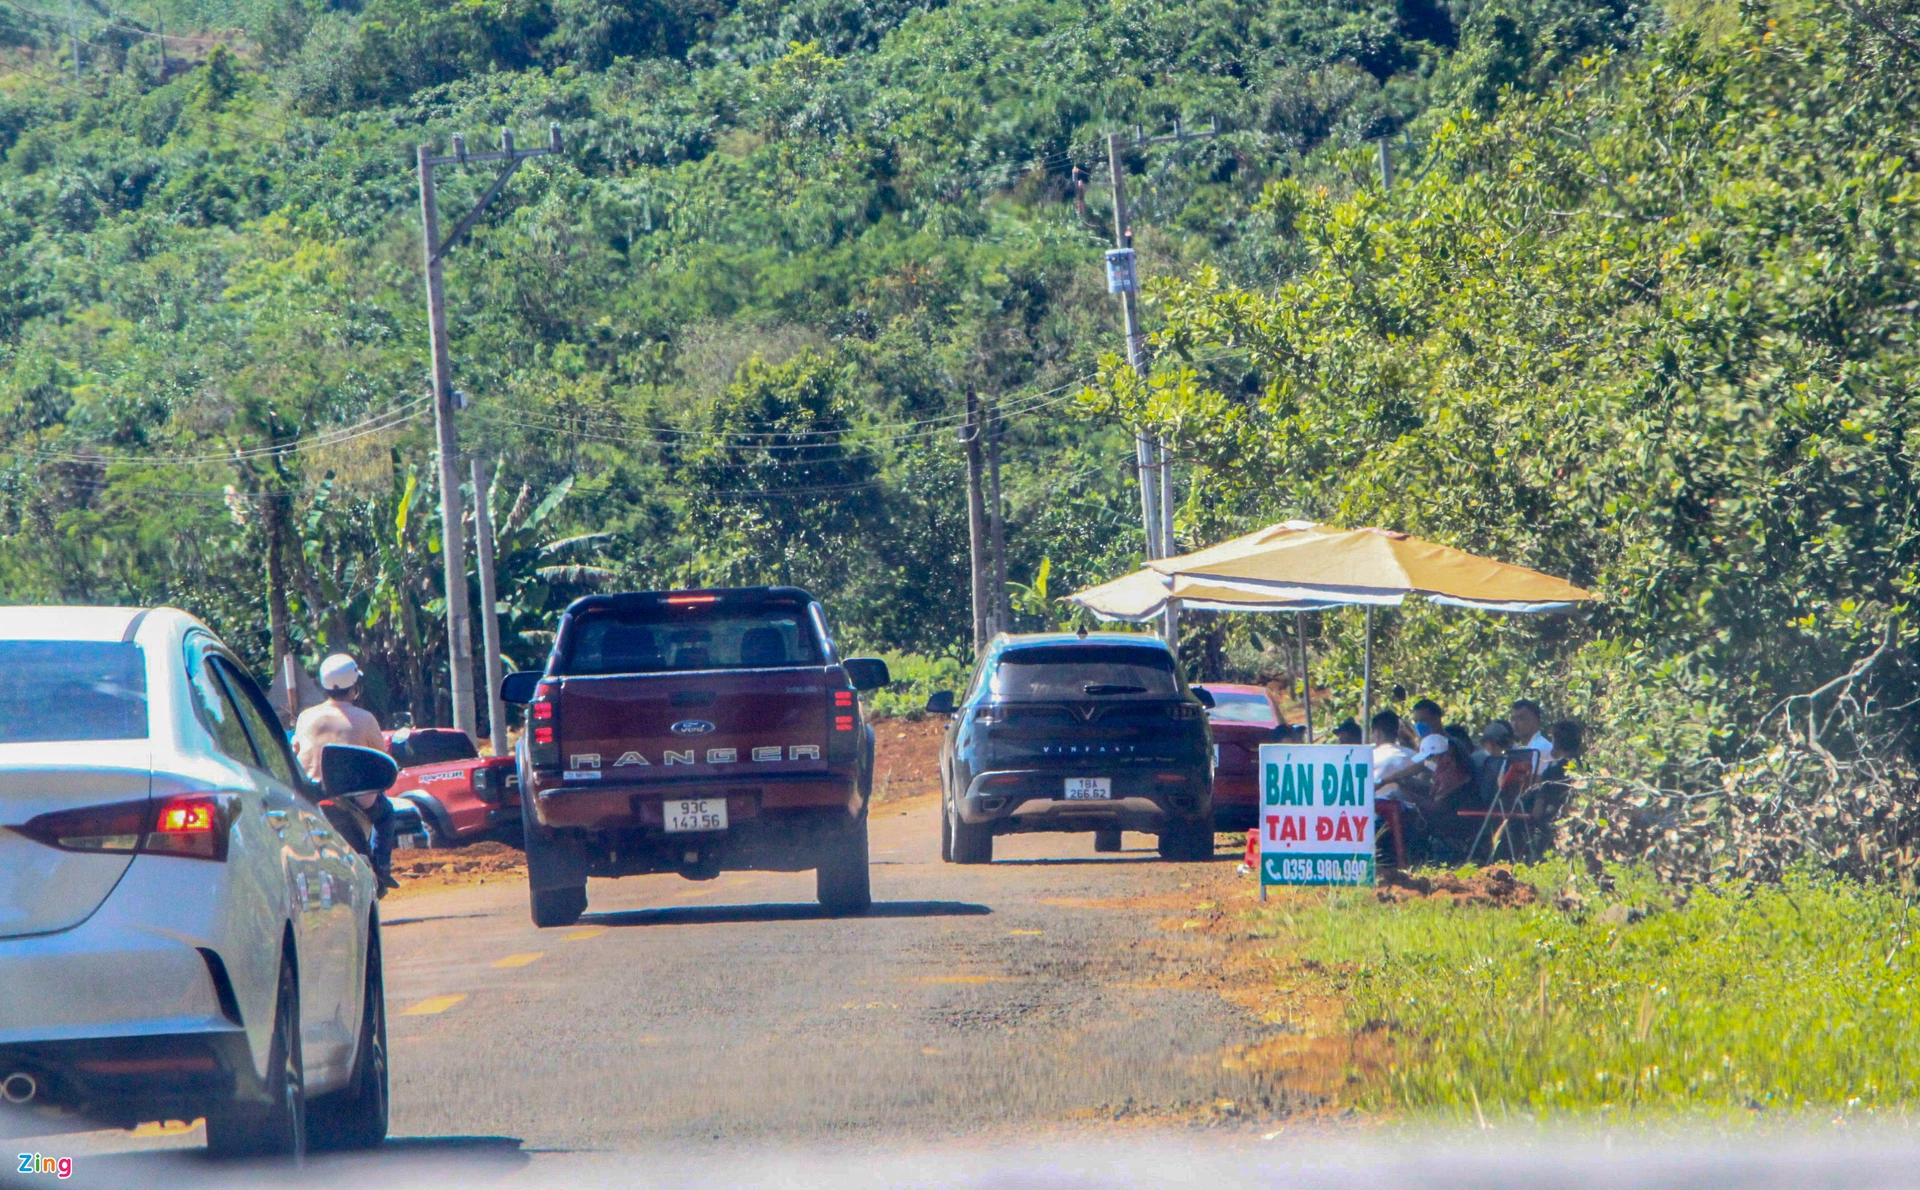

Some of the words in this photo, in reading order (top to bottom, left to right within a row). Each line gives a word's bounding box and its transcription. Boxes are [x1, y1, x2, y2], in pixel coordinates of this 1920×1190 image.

[571, 745, 820, 770] RANGER
[1265, 753, 1314, 806] BÁN
[1321, 749, 1368, 806] ĐẤT
[681, 801, 708, 815] 93C
[1265, 815, 1307, 848] TẠI
[1316, 811, 1369, 842] ĐÂY
